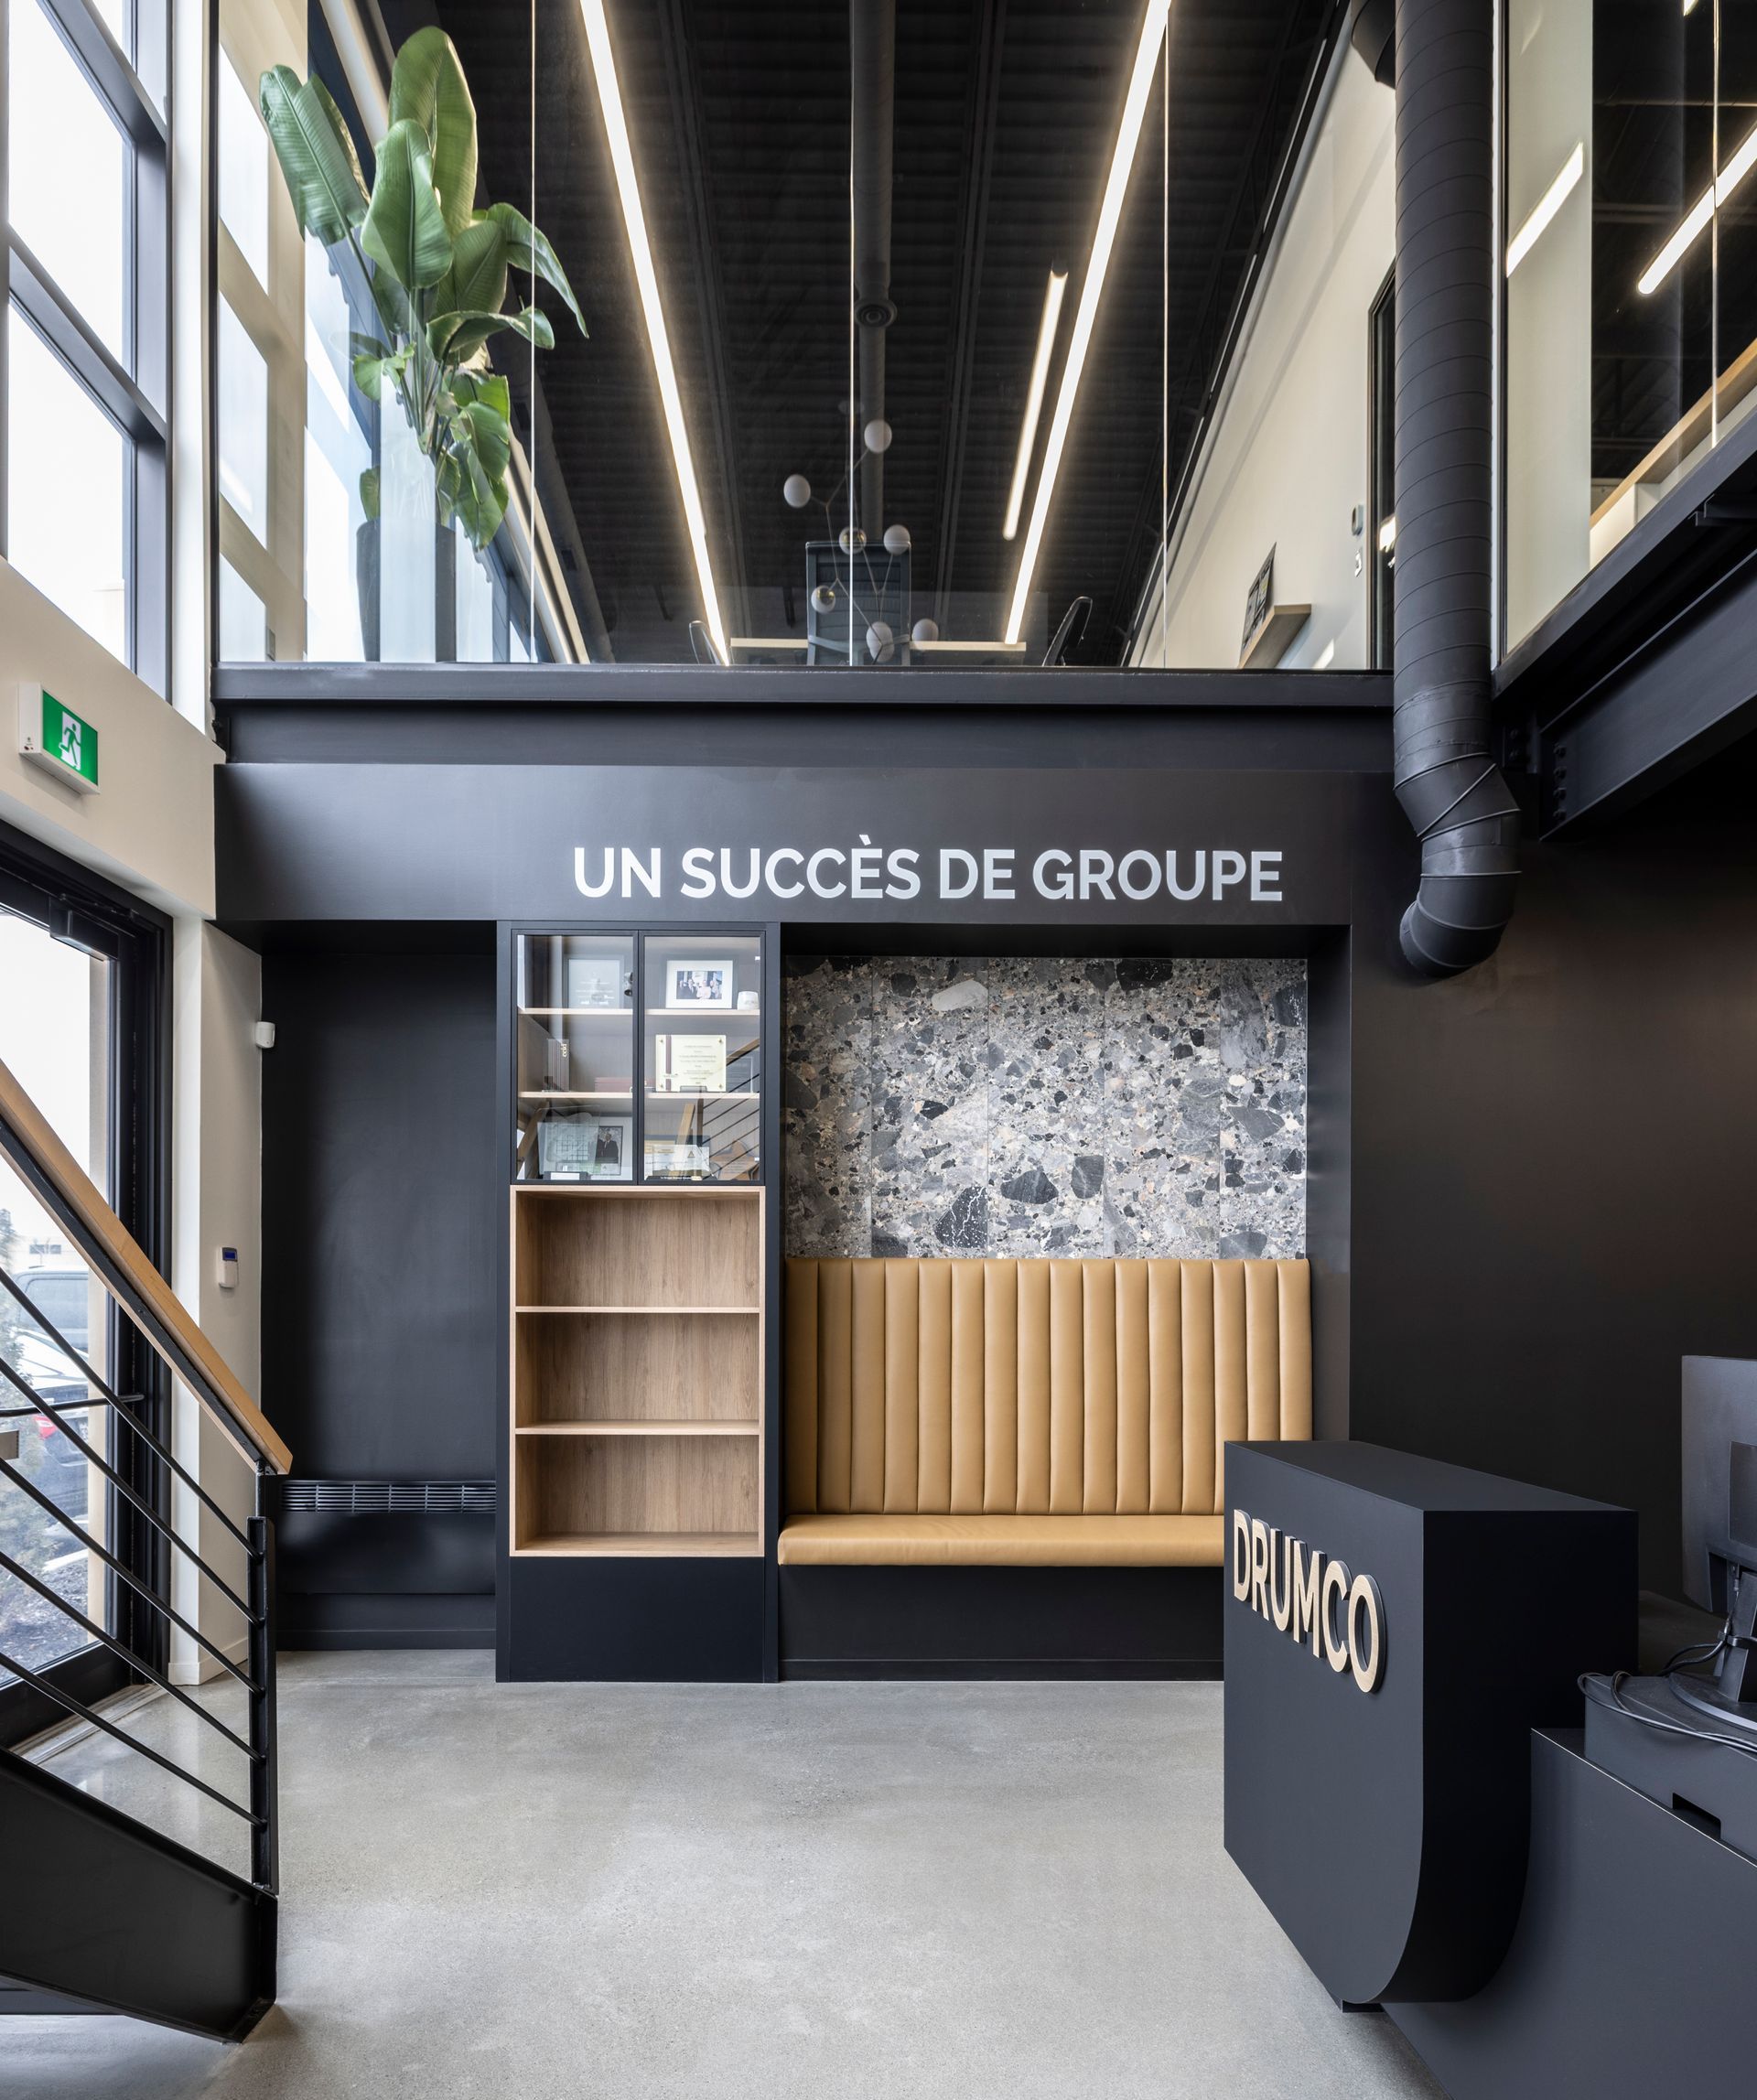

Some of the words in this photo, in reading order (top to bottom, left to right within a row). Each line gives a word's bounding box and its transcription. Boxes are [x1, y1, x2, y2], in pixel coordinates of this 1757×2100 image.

[574, 846, 661, 899] UN
[682, 834, 921, 899] SUCCÈS
[940, 848, 1016, 899] DE
[1032, 849, 1283, 901] GROUPE
[1234, 1509, 1385, 1693] DRUMCO
